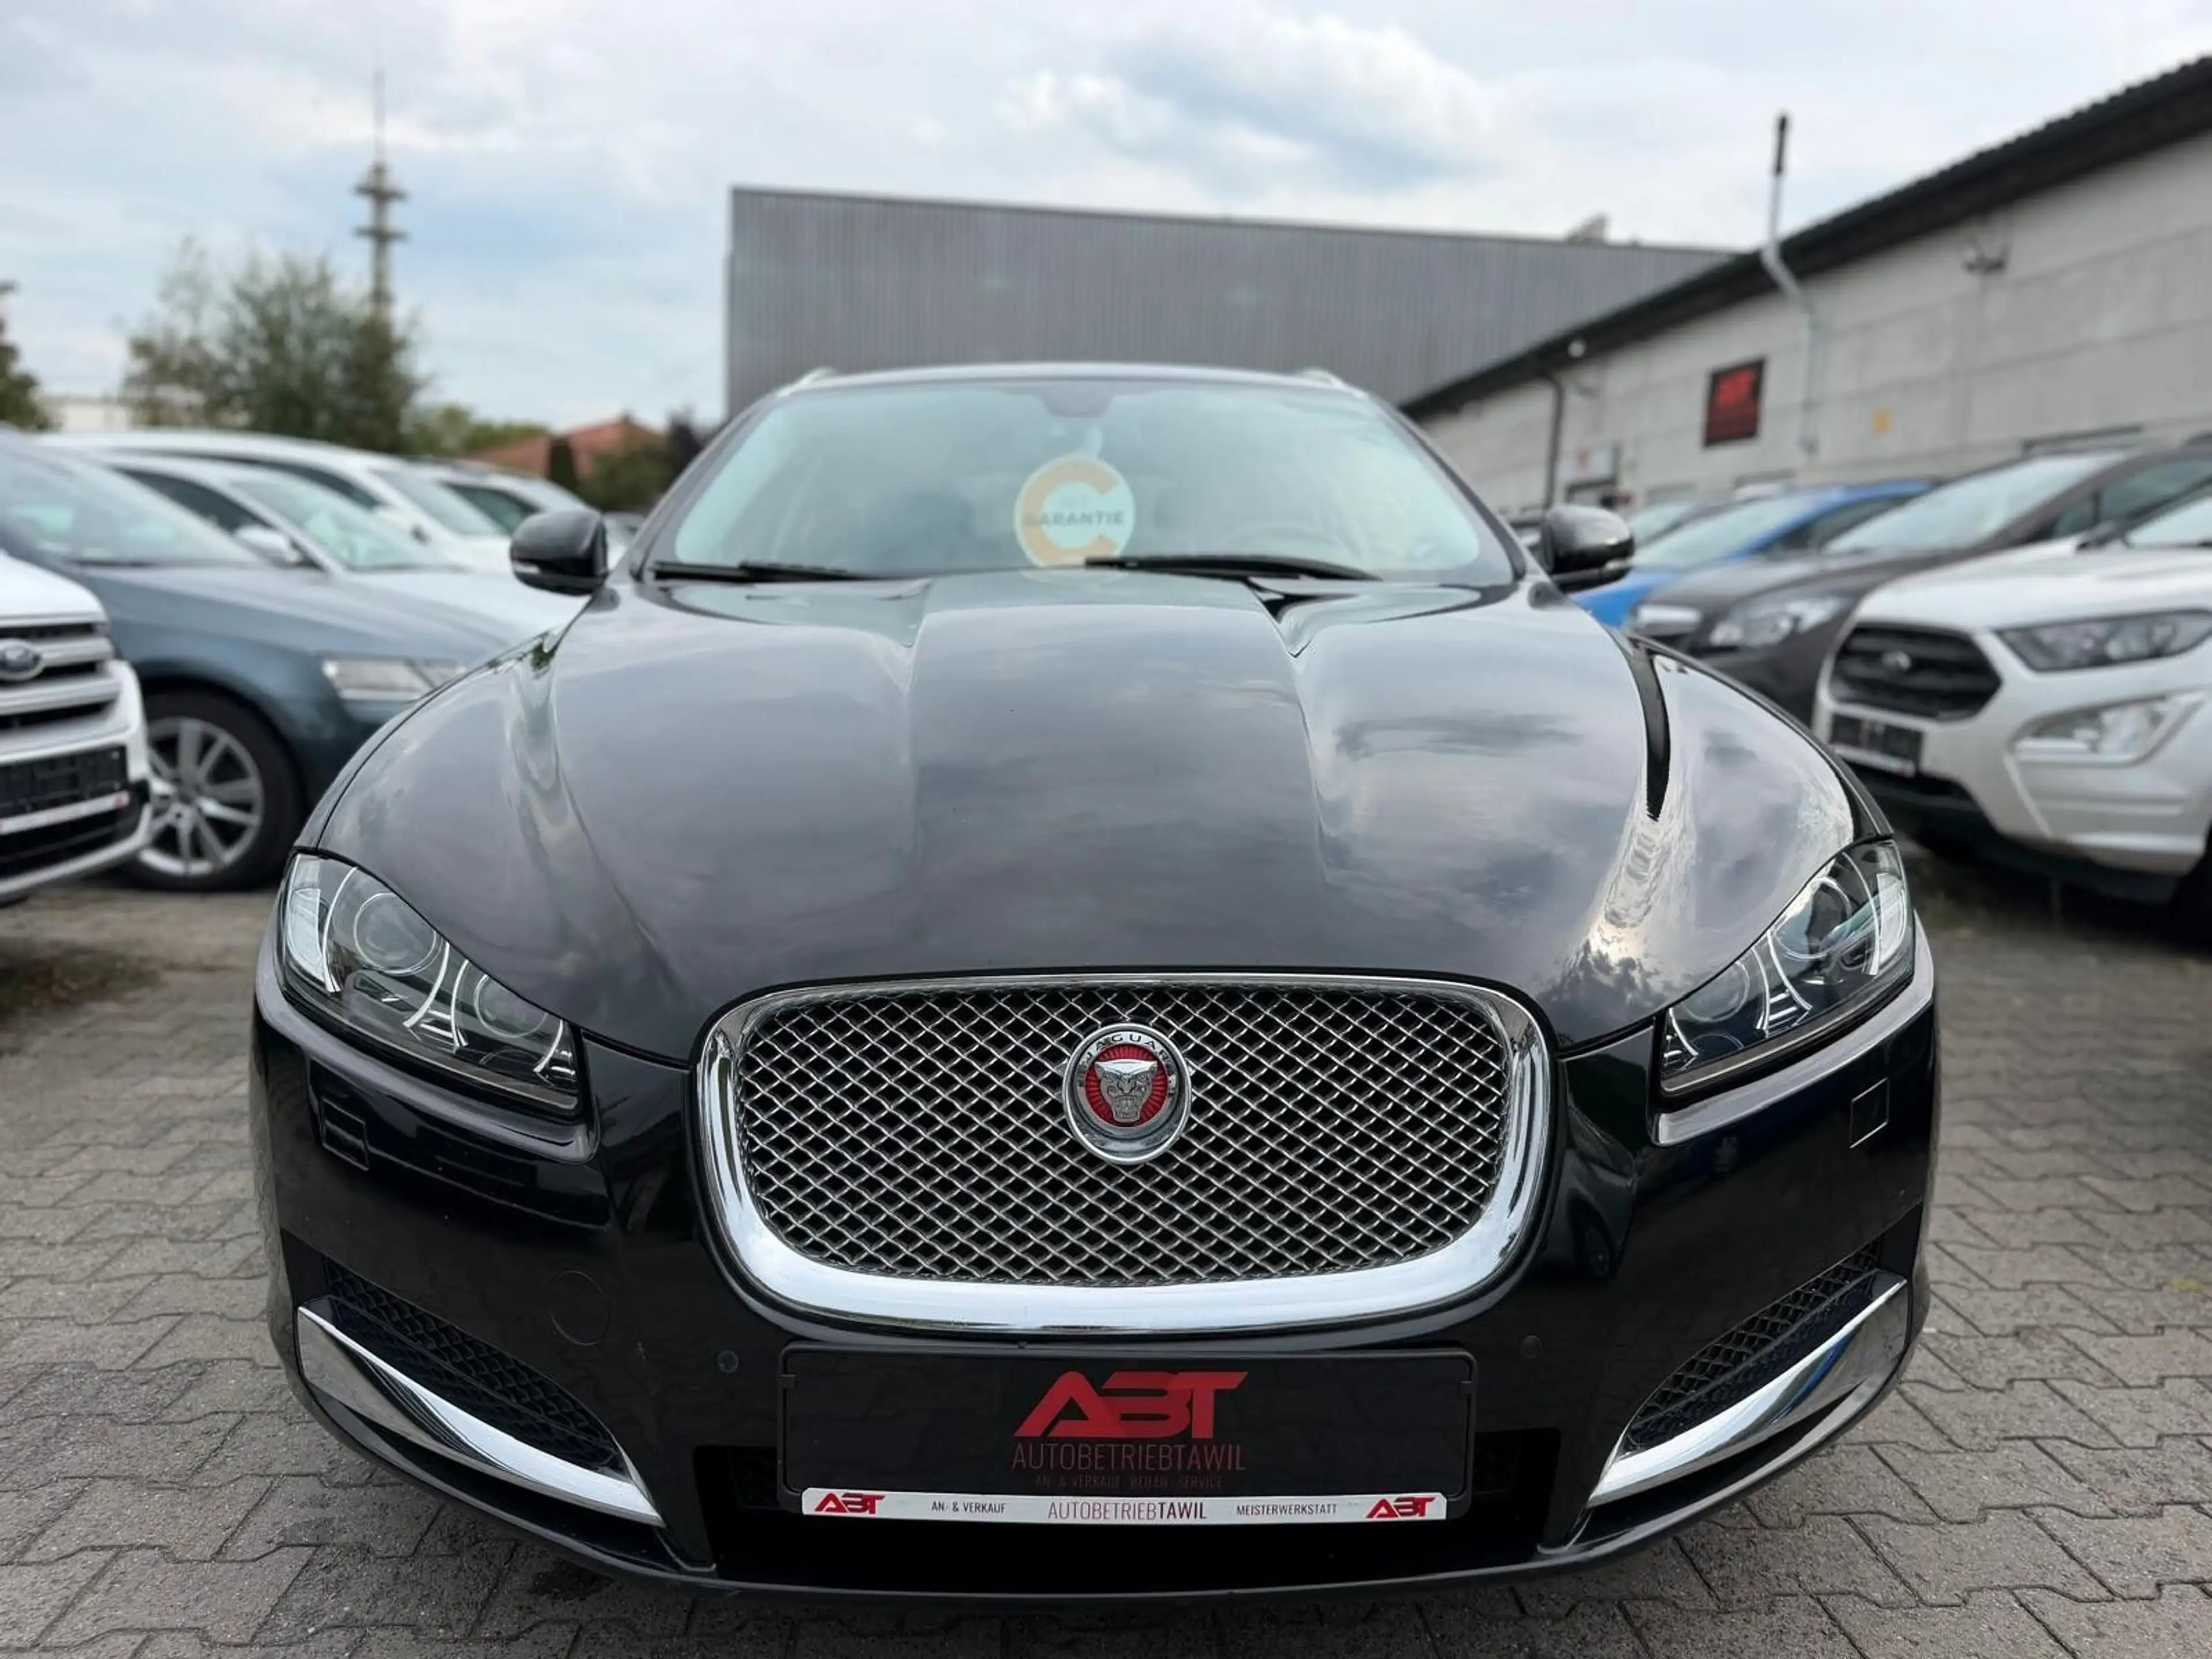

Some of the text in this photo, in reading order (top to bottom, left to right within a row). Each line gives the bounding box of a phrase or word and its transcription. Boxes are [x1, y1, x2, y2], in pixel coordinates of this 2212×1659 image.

[1021, 509, 1124, 525] GARANTIE
[1013, 1371, 1249, 1438] ABT
[1012, 1441, 1247, 1471] AUTOBETRIEBTAWIL
[814, 1493, 885, 1514] ABT
[952, 1501, 959, 1512] &
[963, 1502, 1007, 1514] VERKAUF
[1047, 1501, 1207, 1520] AUTOBETRIEBTAWIL
[1236, 1503, 1338, 1516] MEISTERWERKSTATT
[1366, 1497, 1437, 1519] ABT
